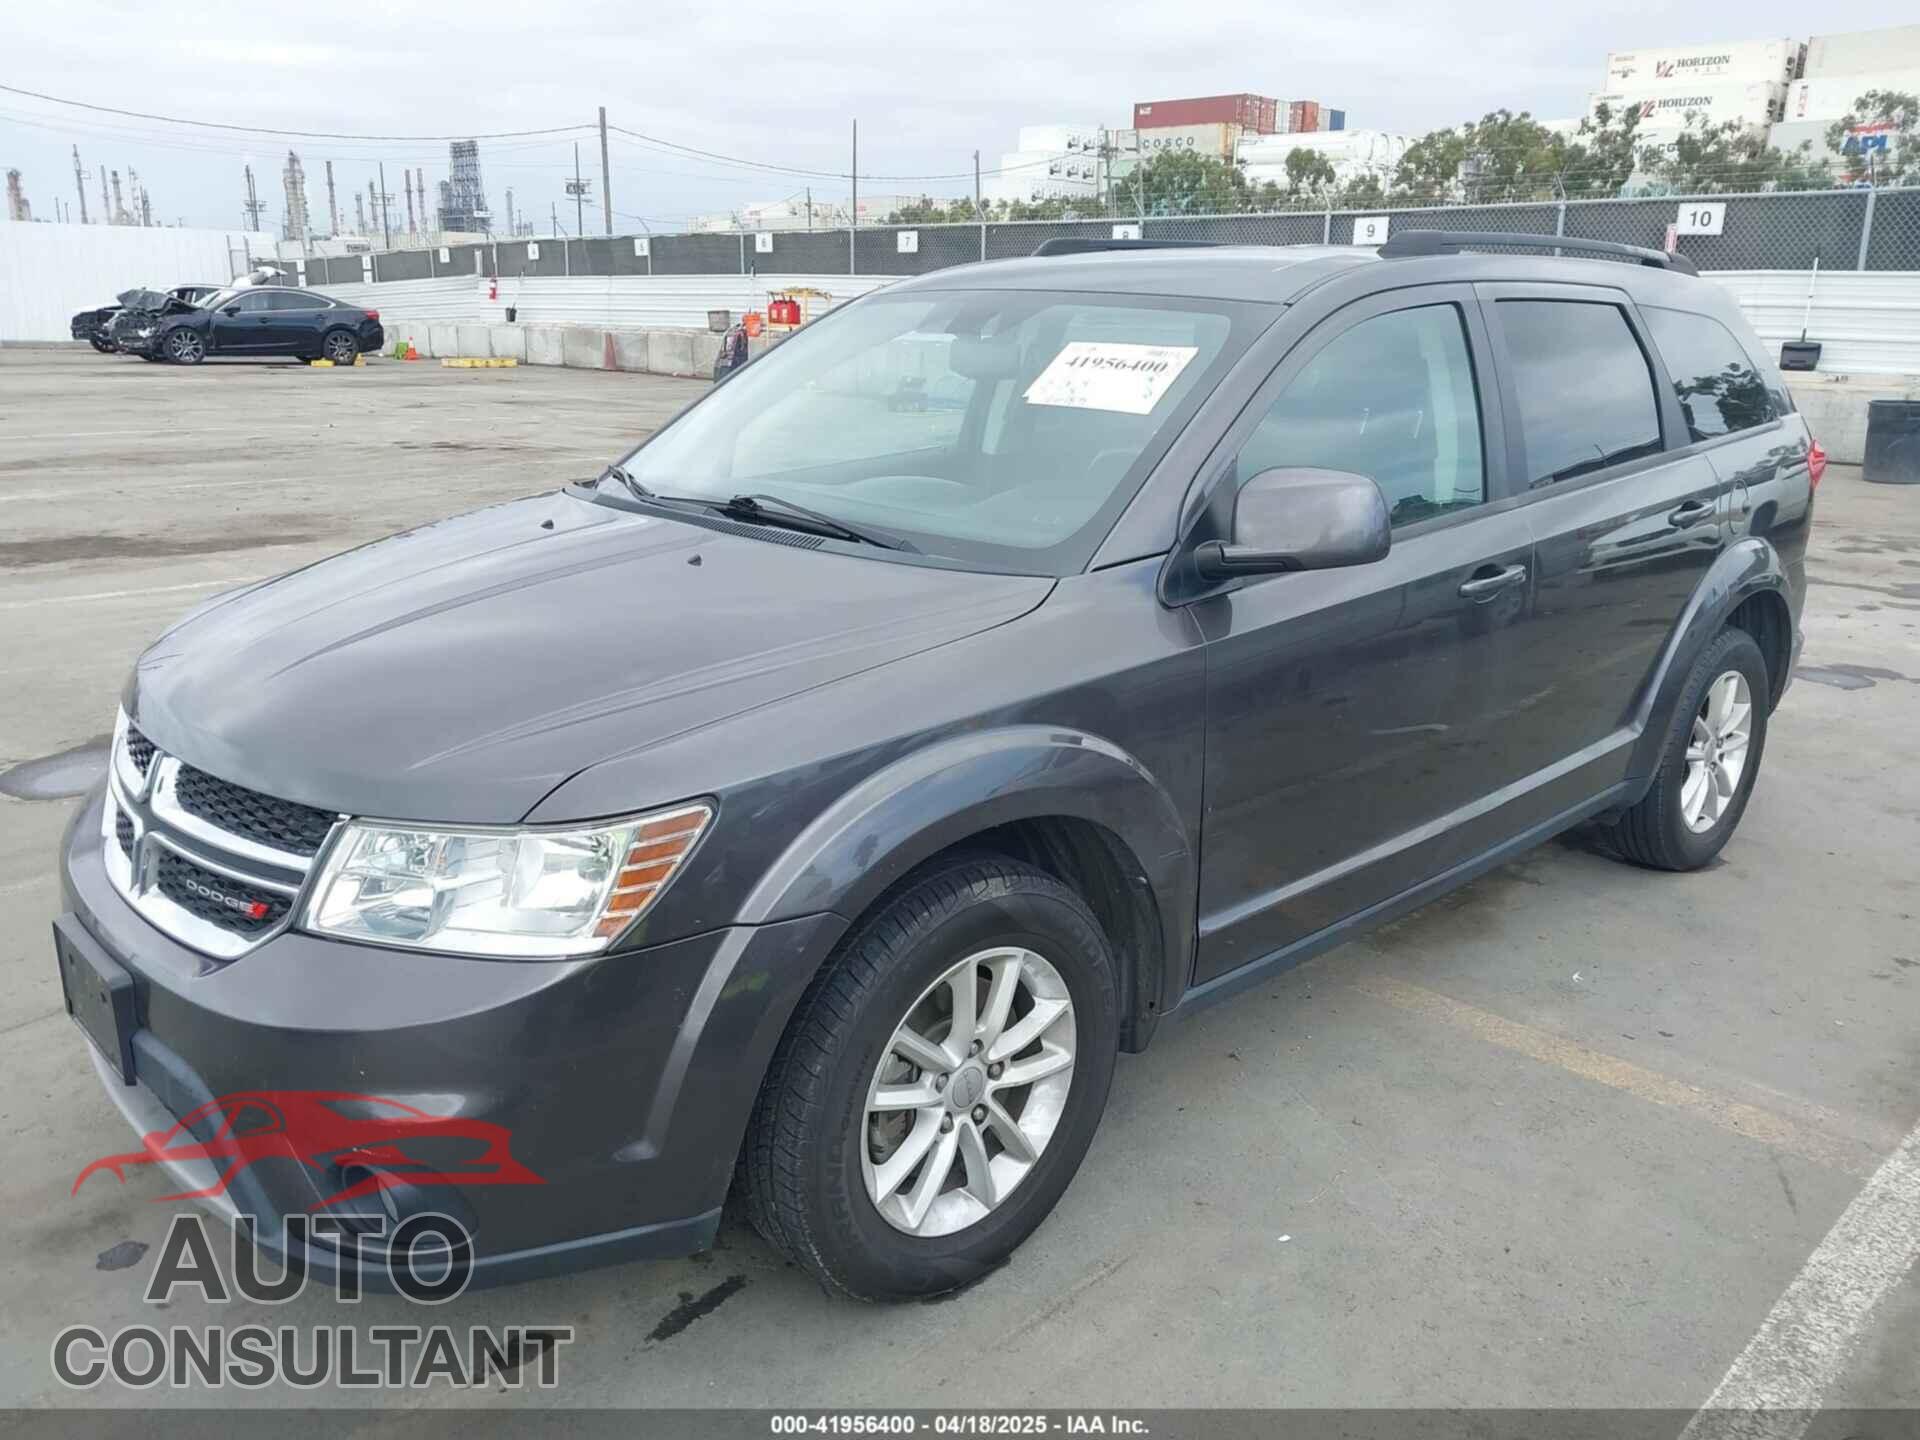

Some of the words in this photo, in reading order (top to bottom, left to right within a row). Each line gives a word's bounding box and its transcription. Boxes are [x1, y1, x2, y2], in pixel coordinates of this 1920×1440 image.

[1676, 55, 1731, 68] HORIZON
[1657, 96, 1712, 109] HORIZON
[1143, 136, 1195, 150] COSCO
[1689, 210, 1712, 227] 10
[1367, 223, 1376, 238] 9
[1066, 355, 1169, 374] 41956400
[186, 879, 254, 914] DODGE
